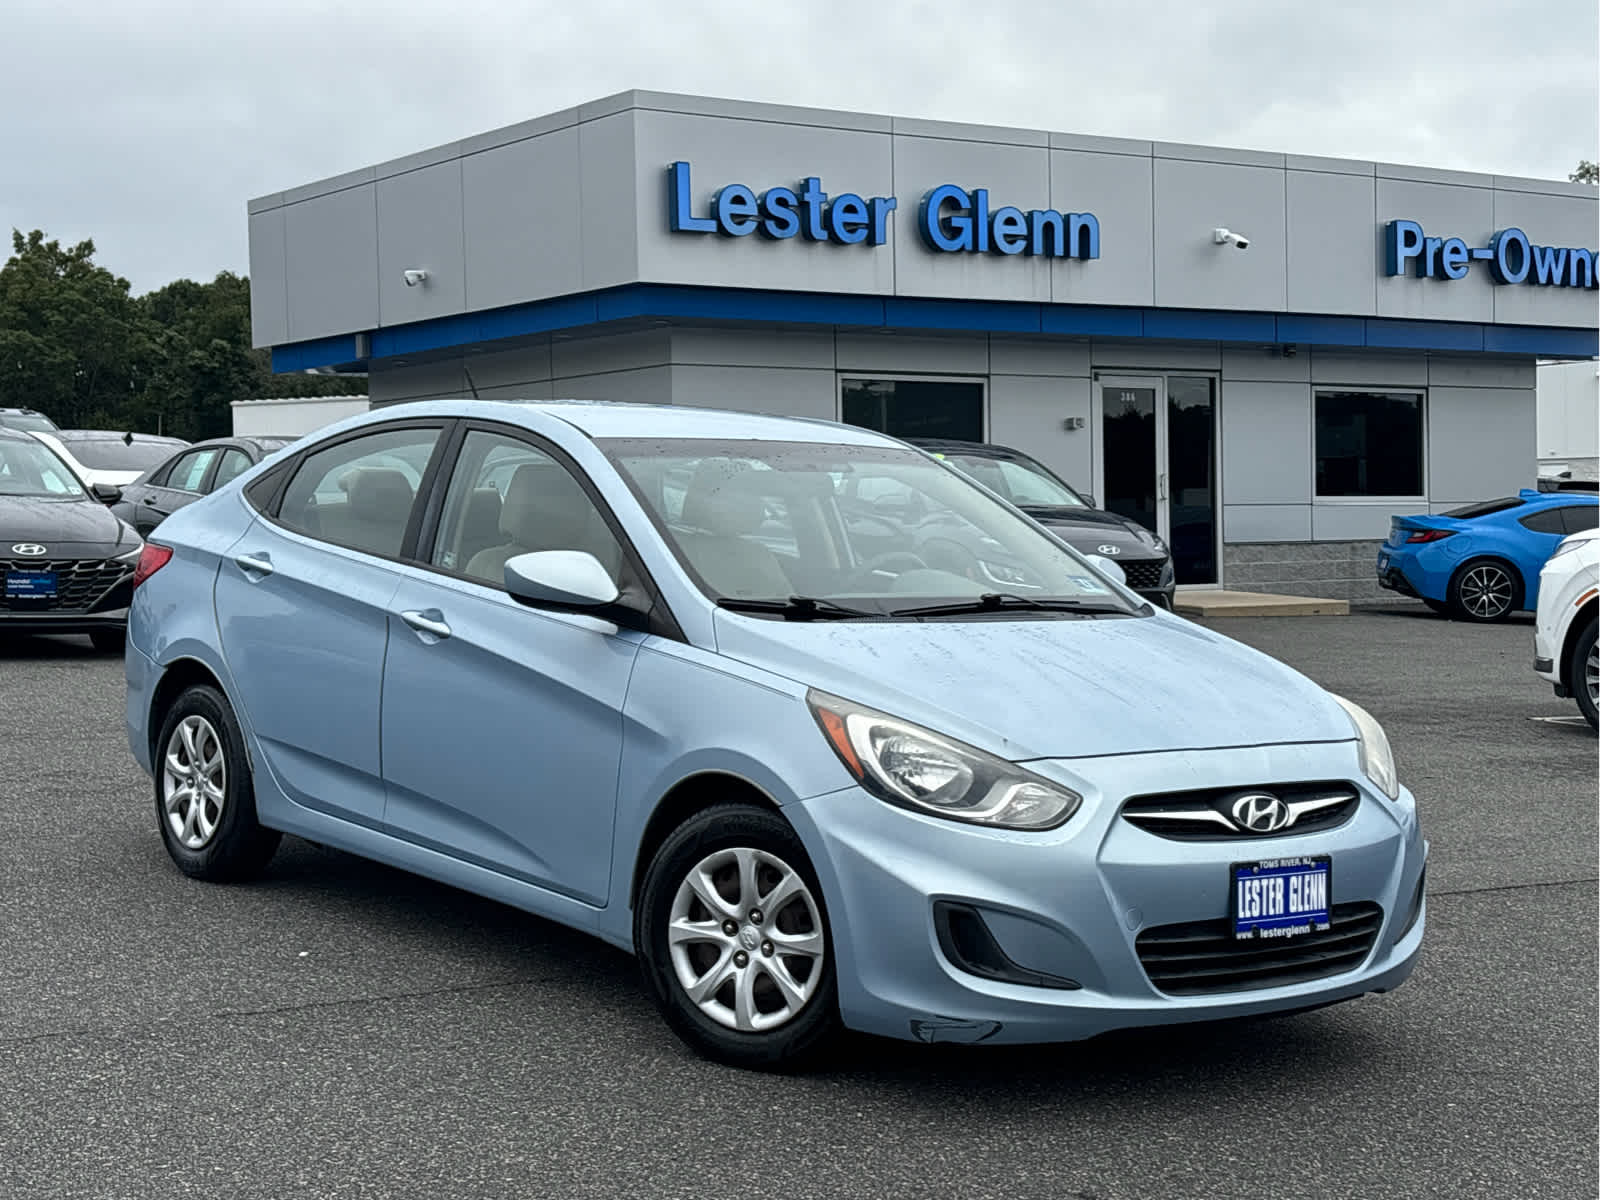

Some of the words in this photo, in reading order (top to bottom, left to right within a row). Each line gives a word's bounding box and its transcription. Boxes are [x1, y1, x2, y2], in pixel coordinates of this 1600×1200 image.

[671, 161, 897, 246] Lester
[919, 184, 1100, 259] Glenn
[1386, 219, 1599, 288] Pre-Own
[1260, 860, 1279, 869] TOMS
[1303, 857, 1311, 865] NJ
[1238, 878, 1284, 918] LESTER
[1289, 873, 1326, 913] GLENN
[1260, 925, 1310, 938] lesterglenn
